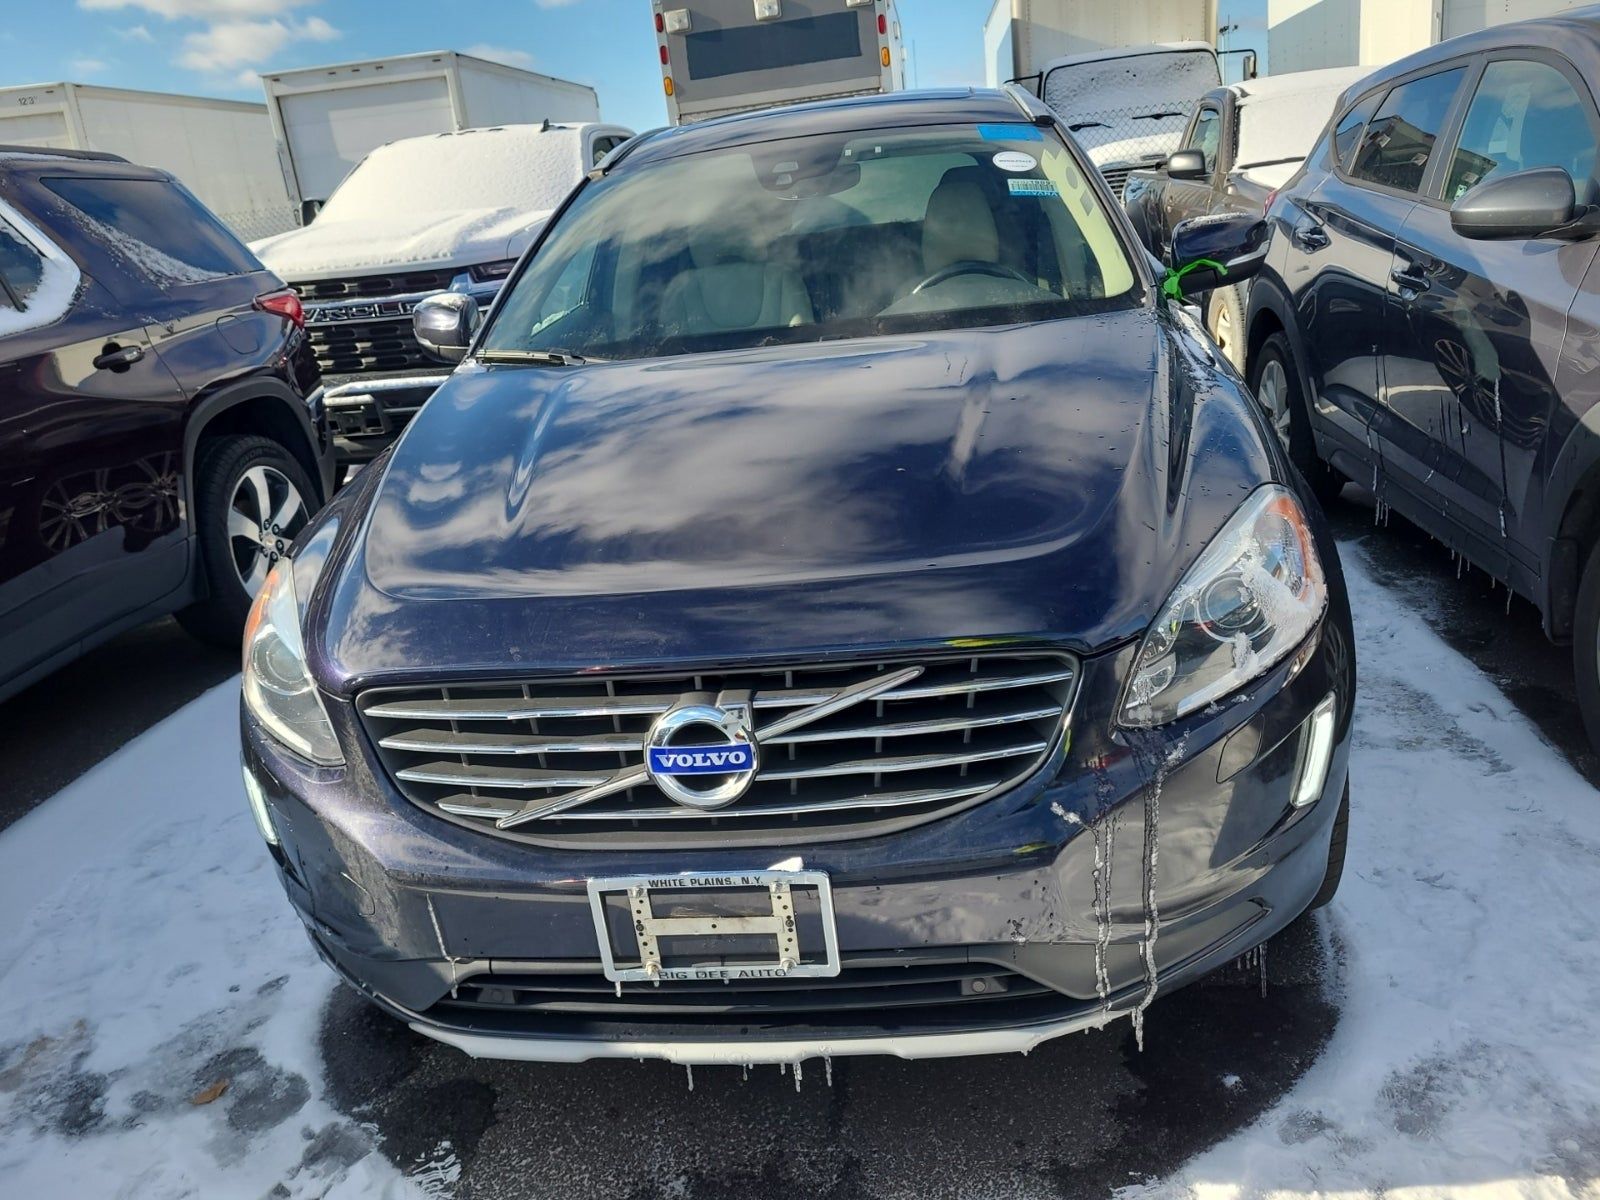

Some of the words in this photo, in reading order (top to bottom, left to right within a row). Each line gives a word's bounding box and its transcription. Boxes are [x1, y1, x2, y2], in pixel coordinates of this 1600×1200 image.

[656, 751, 746, 768] VOLVO
[648, 878, 686, 888] WHITE
[741, 876, 763, 885] N.Y.
[738, 968, 787, 978] AUTO
